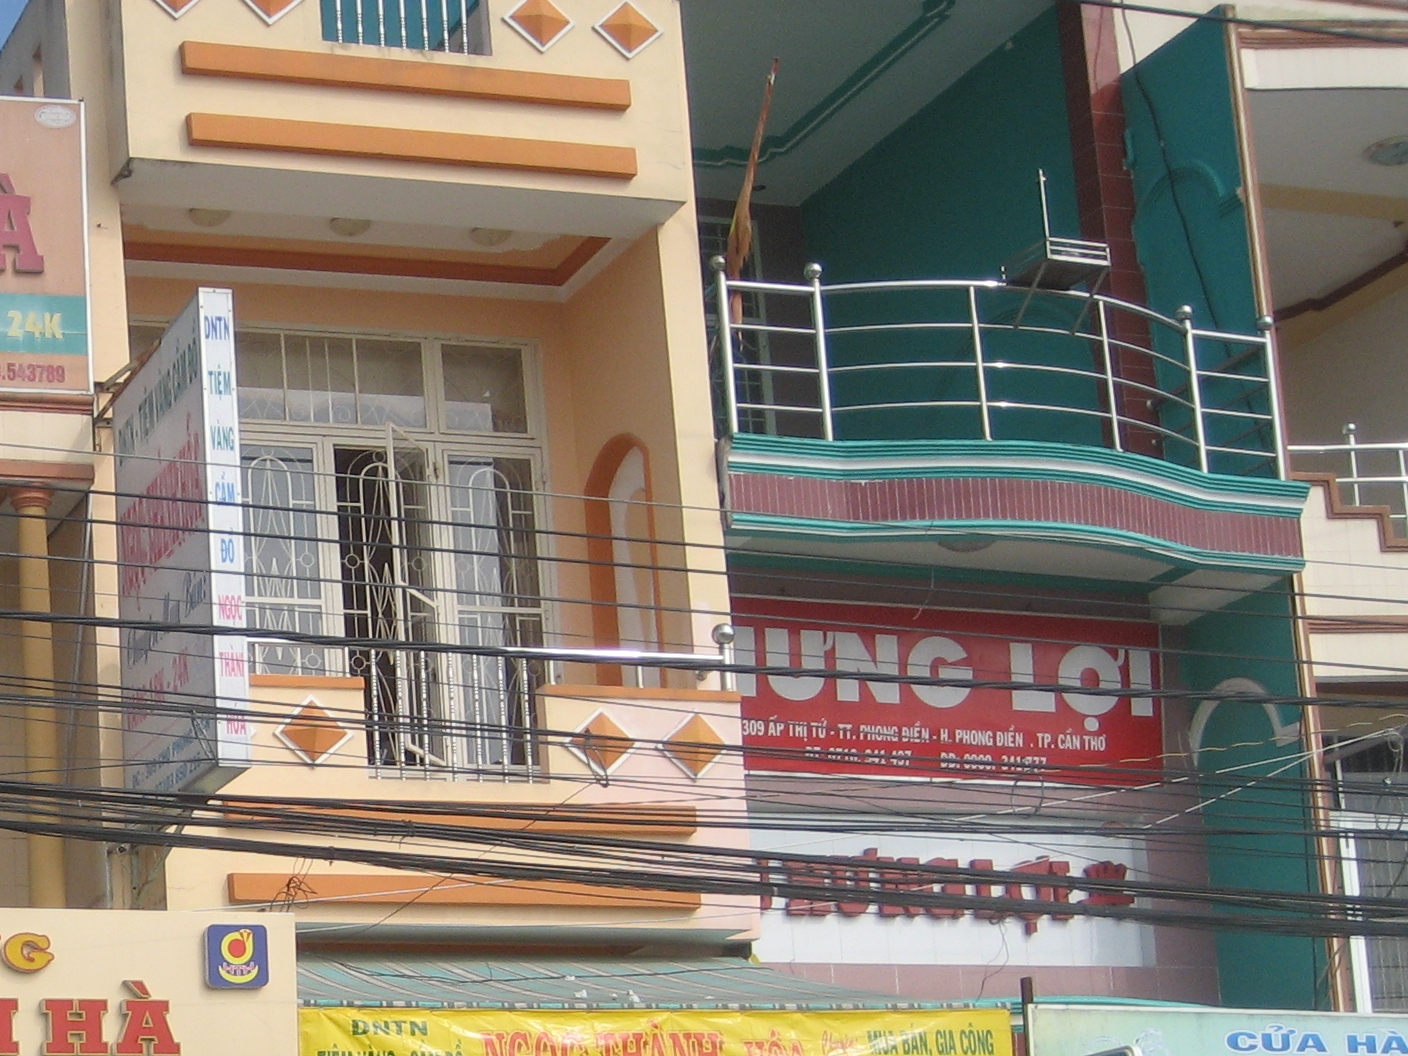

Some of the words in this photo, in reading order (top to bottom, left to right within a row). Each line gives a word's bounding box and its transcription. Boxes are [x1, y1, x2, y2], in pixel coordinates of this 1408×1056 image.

[6, 310, 64, 339] 24K
[203, 315, 231, 341] DNTN
[210, 419, 234, 451] VÀNG
[1009, 643, 1153, 732] LỢI
[742, 718, 764, 736] 309
[955, 728, 993, 747] PHONG
[996, 724, 1024, 749] ĐIỀN
[1057, 726, 1082, 751] CẦN
[352, 1019, 428, 1037] DNTN
[935, 1029, 956, 1056] GIA
[959, 1022, 995, 1056] CÔNG
[1226, 1023, 1329, 1053] CỬA
